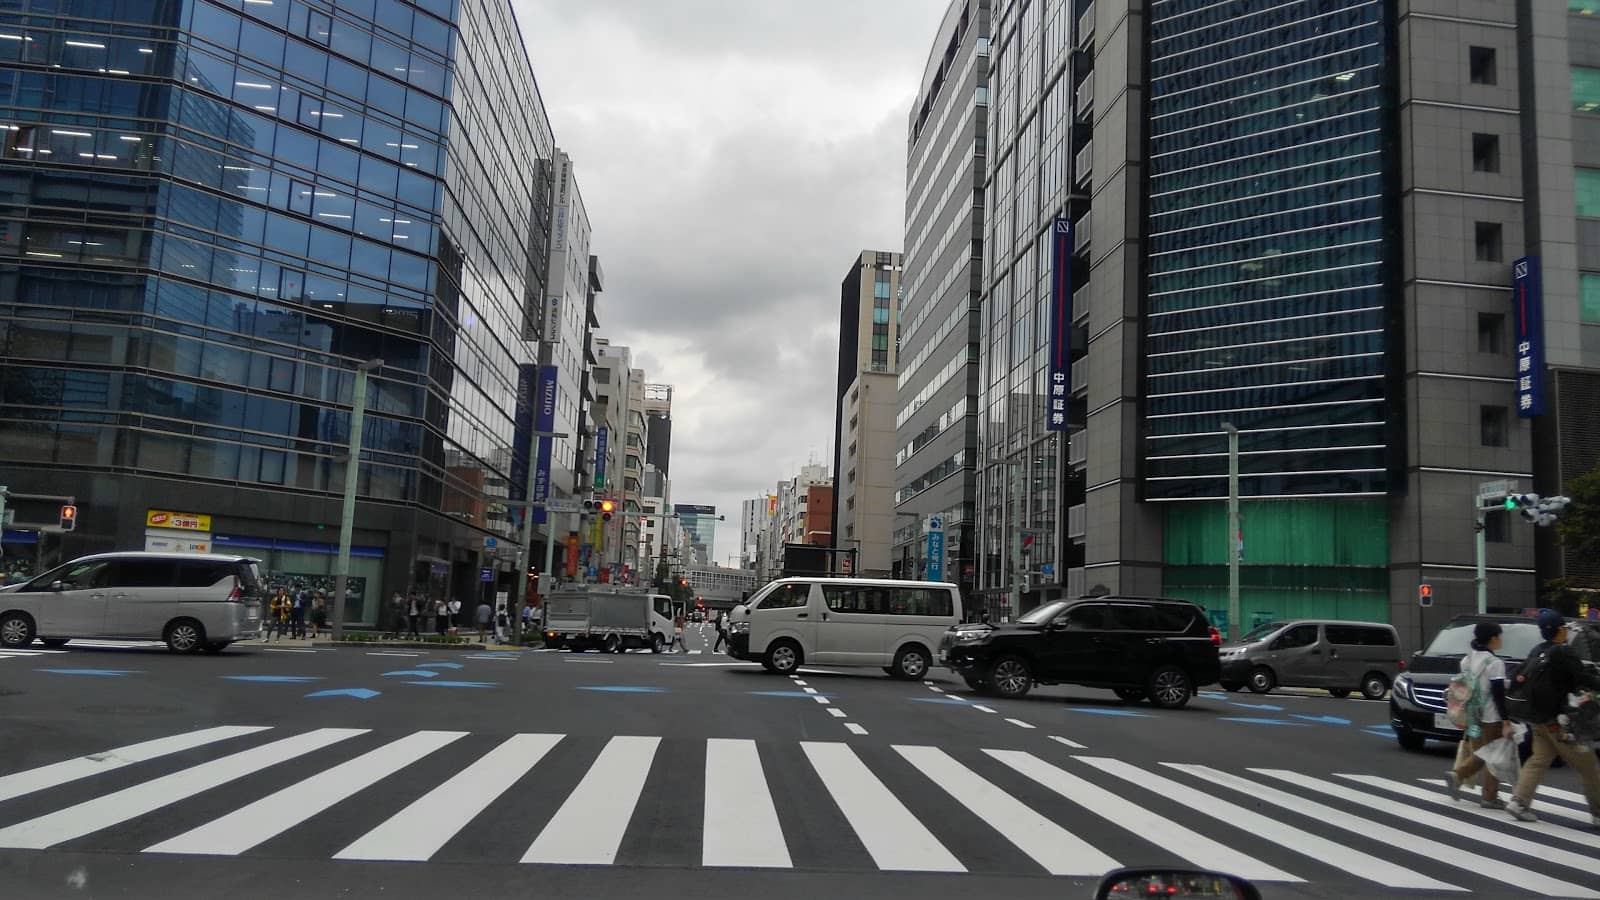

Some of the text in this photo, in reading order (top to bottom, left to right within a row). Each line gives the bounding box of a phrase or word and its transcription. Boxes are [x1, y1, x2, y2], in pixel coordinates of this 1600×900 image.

[1052, 371, 1065, 424] 中原証券
[1519, 341, 1532, 410] 中原証券
